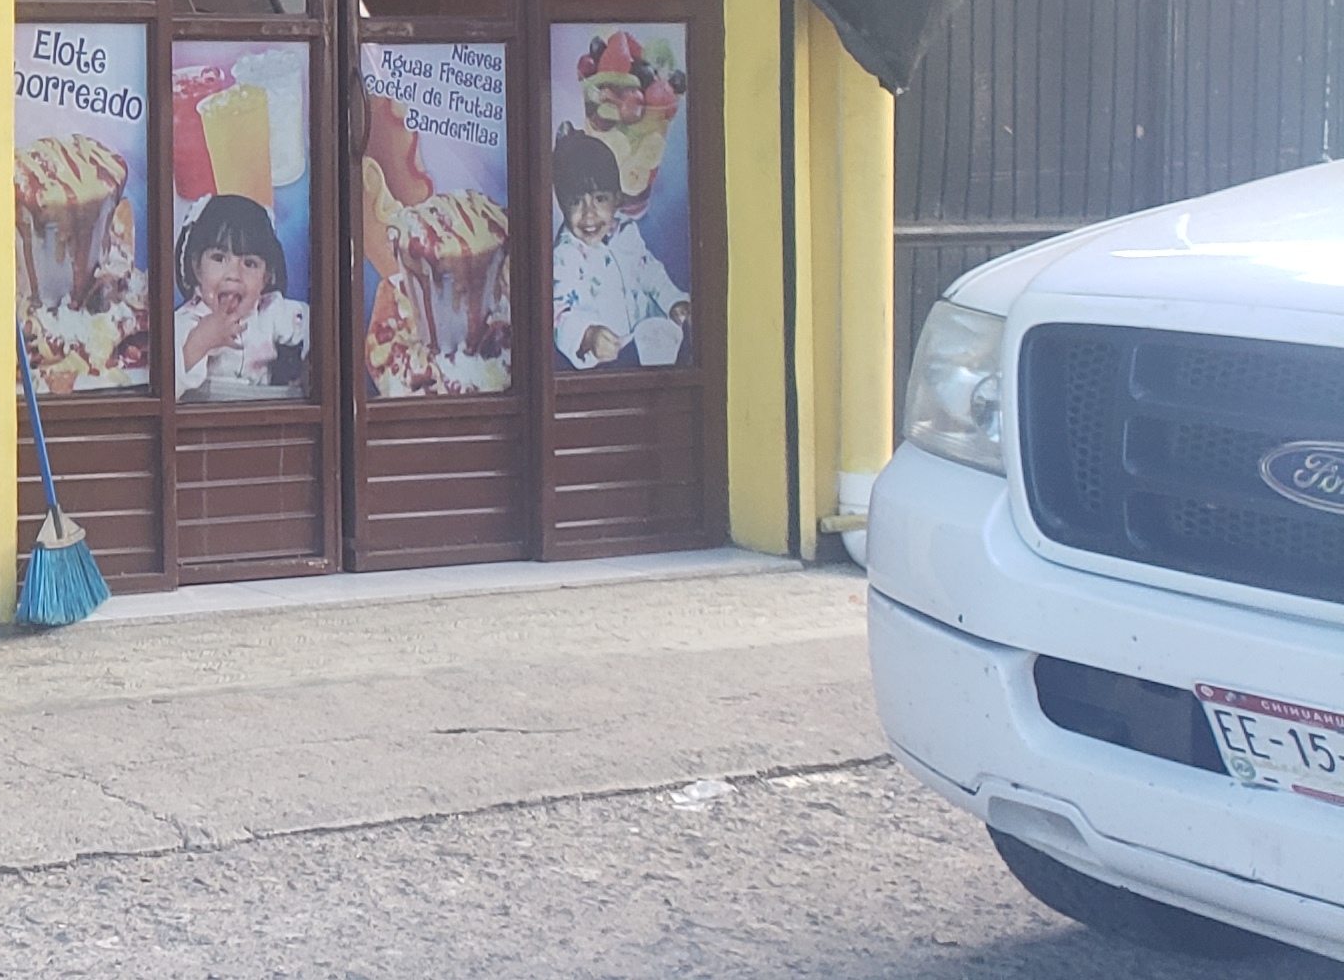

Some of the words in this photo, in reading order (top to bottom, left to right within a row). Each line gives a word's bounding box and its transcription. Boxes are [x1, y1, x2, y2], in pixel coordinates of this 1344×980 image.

[33, 29, 107, 74] Elote
[381, 50, 433, 78] Aguas
[439, 62, 503, 94] Frescas
[451, 45, 502, 71] Nieves
[13, 62, 143, 120] horreado
[422, 87, 442, 107] de
[448, 90, 503, 120] Frutas
[406, 108, 499, 146] Banderillas
